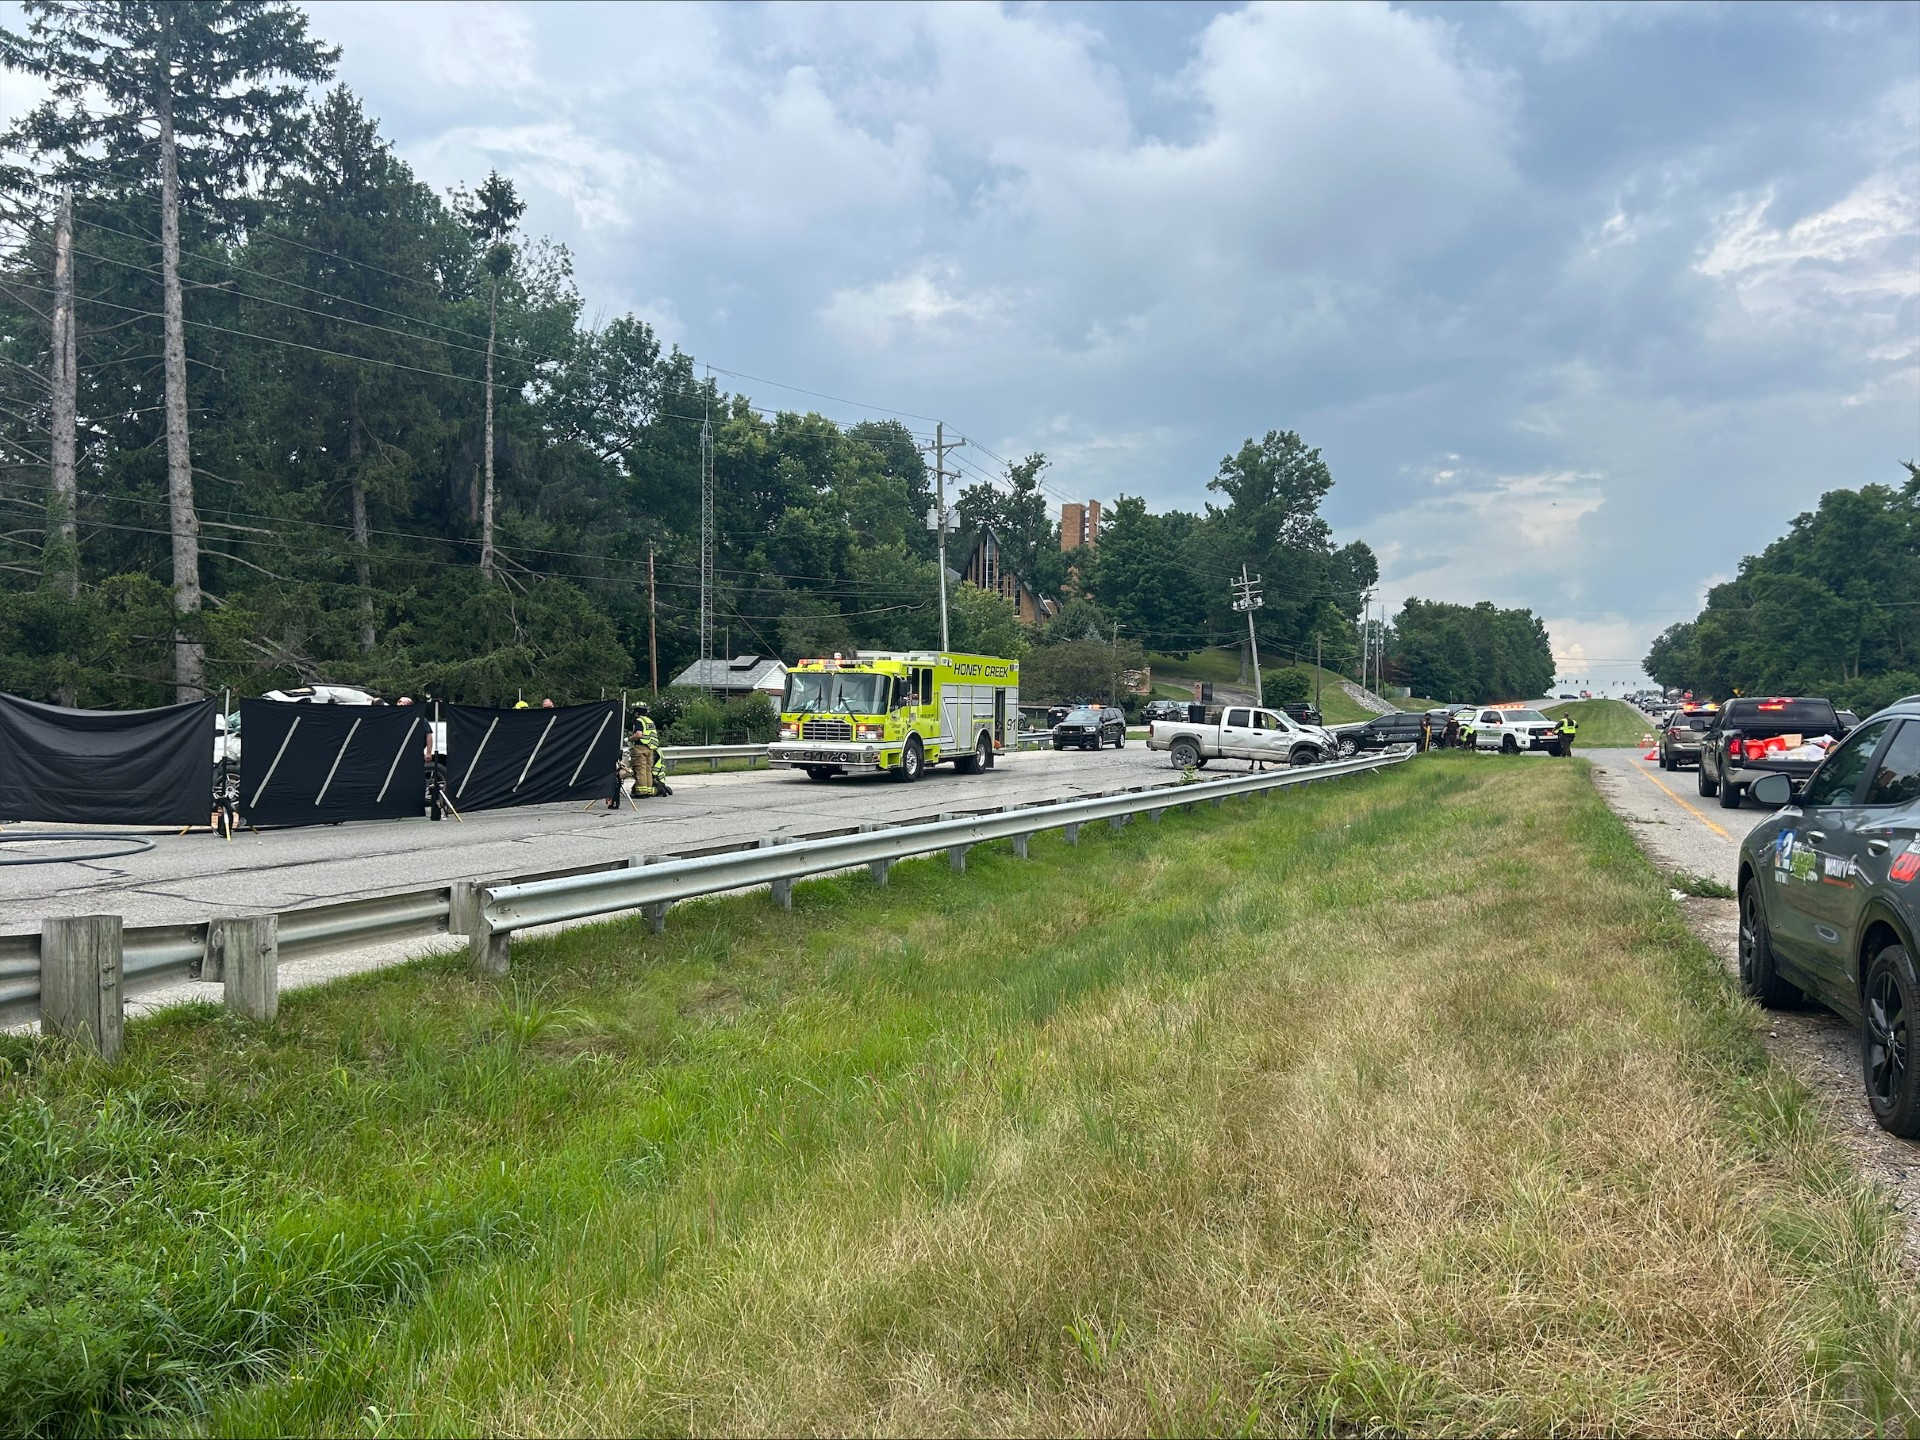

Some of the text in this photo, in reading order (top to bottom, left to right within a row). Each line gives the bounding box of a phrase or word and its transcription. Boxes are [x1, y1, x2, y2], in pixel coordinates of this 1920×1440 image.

[953, 663, 1009, 678] HONEY CREEK
[1006, 718, 1016, 731] 91
[1782, 832, 1794, 870] 2
[1825, 858, 1848, 878] WAWV
